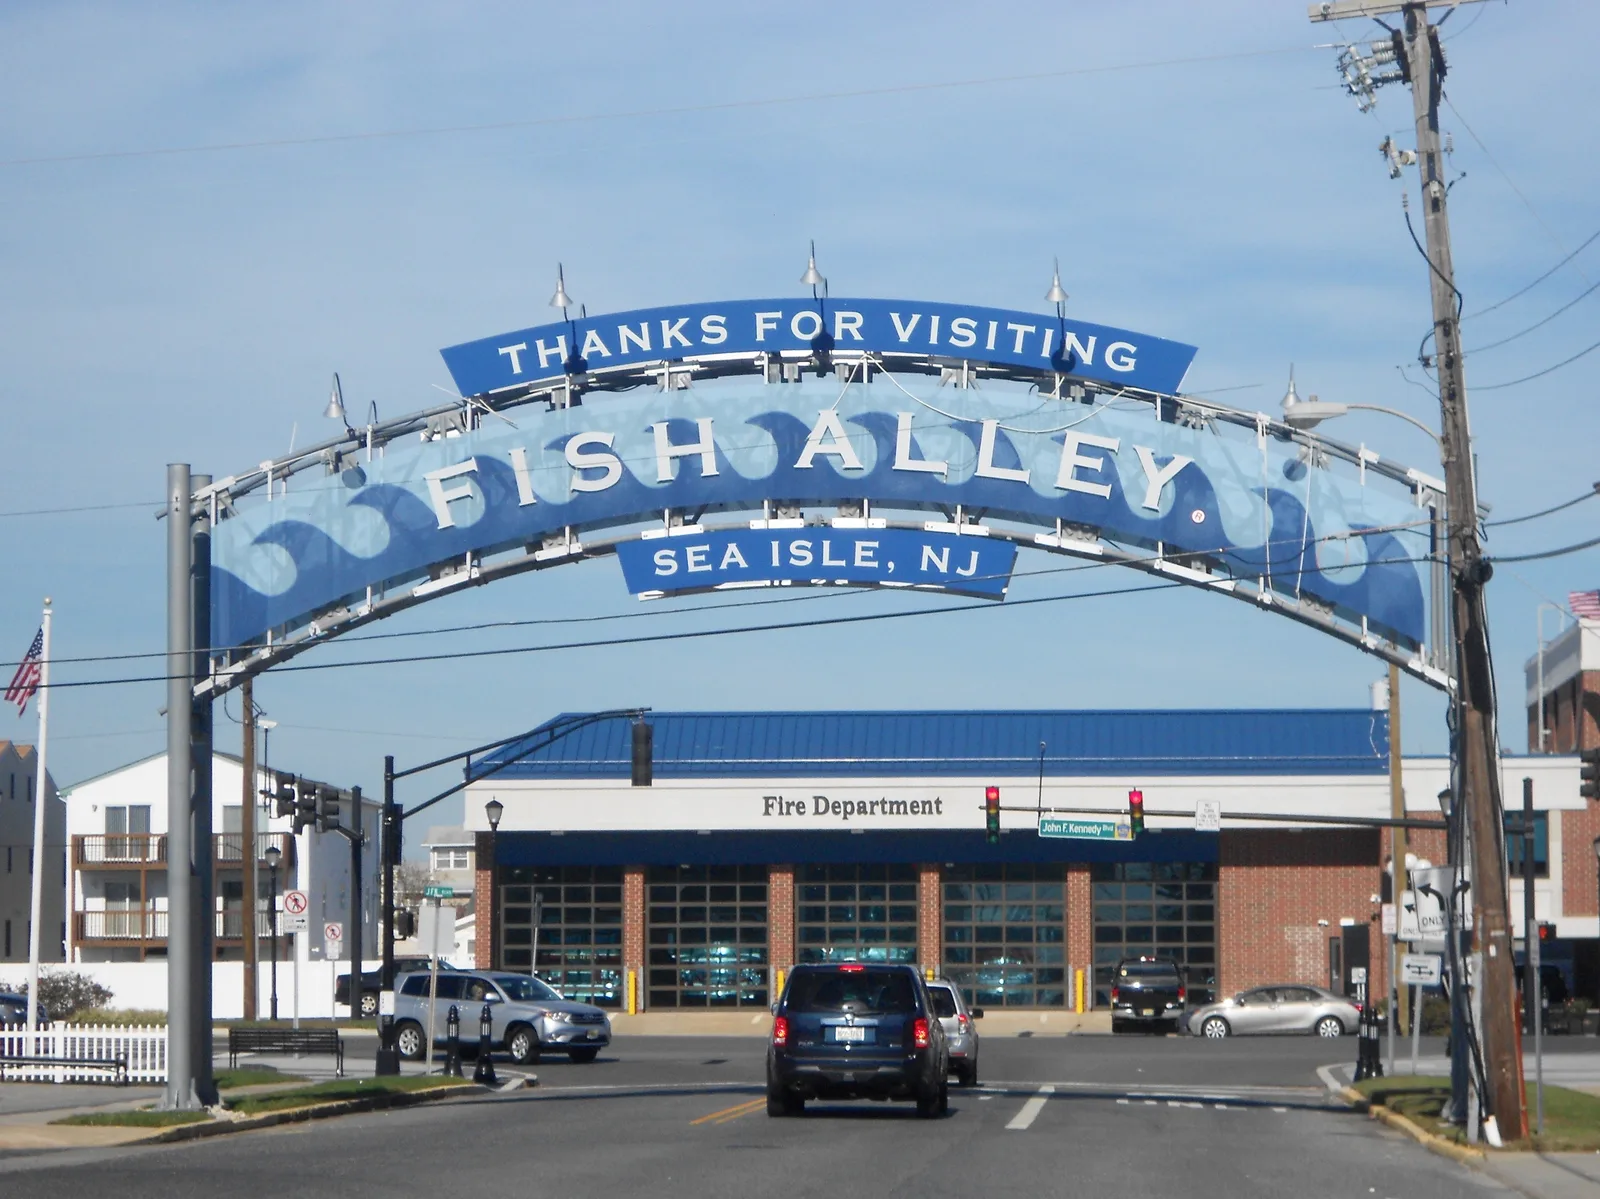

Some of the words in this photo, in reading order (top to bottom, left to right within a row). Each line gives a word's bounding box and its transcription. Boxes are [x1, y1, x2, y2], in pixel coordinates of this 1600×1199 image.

[498, 314, 728, 374] THANKS
[755, 310, 863, 342] FOR
[890, 311, 1138, 372] VISITING
[423, 417, 720, 529] FISH
[793, 409, 1194, 512] ALLEY
[653, 542, 748, 576] SEA
[771, 539, 895, 574] ISLE,
[920, 545, 979, 577] NJ
[762, 796, 806, 816] Fire
[812, 796, 943, 820] Department
[1042, 822, 1061, 832] John
[1062, 823, 1068, 833] F.
[1069, 823, 1101, 836] Kennedy
[1422, 916, 1445, 926] ONLY
